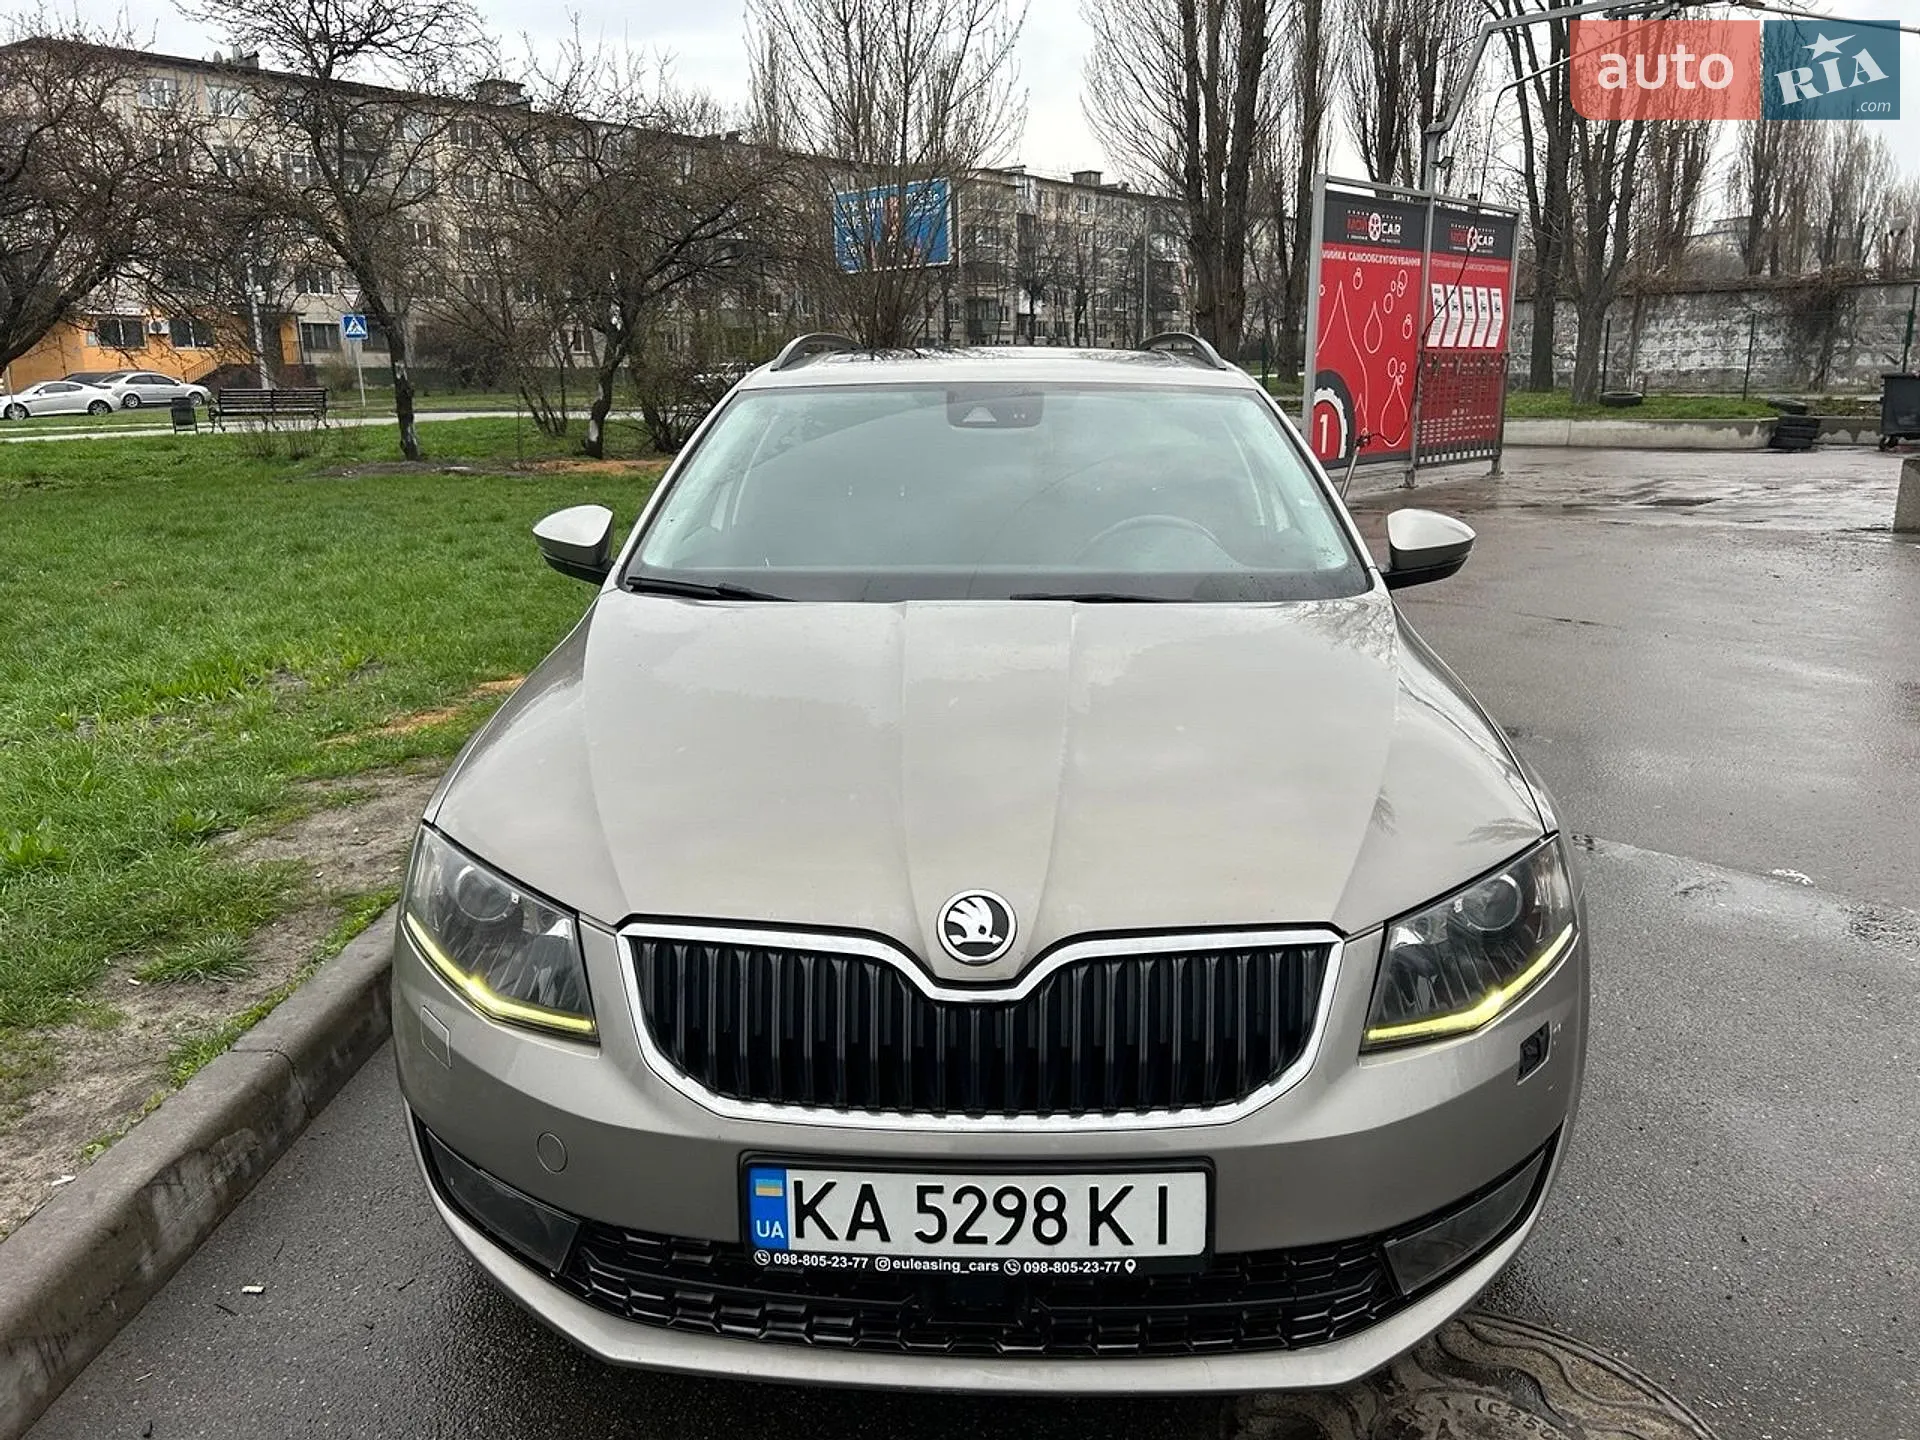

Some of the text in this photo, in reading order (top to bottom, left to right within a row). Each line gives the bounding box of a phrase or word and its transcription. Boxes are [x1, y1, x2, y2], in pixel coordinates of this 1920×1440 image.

[1320, 413, 1328, 454] 1
[793, 1180, 891, 1242] KA
[914, 1184, 1068, 1246] 5298
[756, 1219, 785, 1239] UA
[773, 1252, 1121, 1274] 098-805-23-77 euleasing_cars 098-805-23-77
